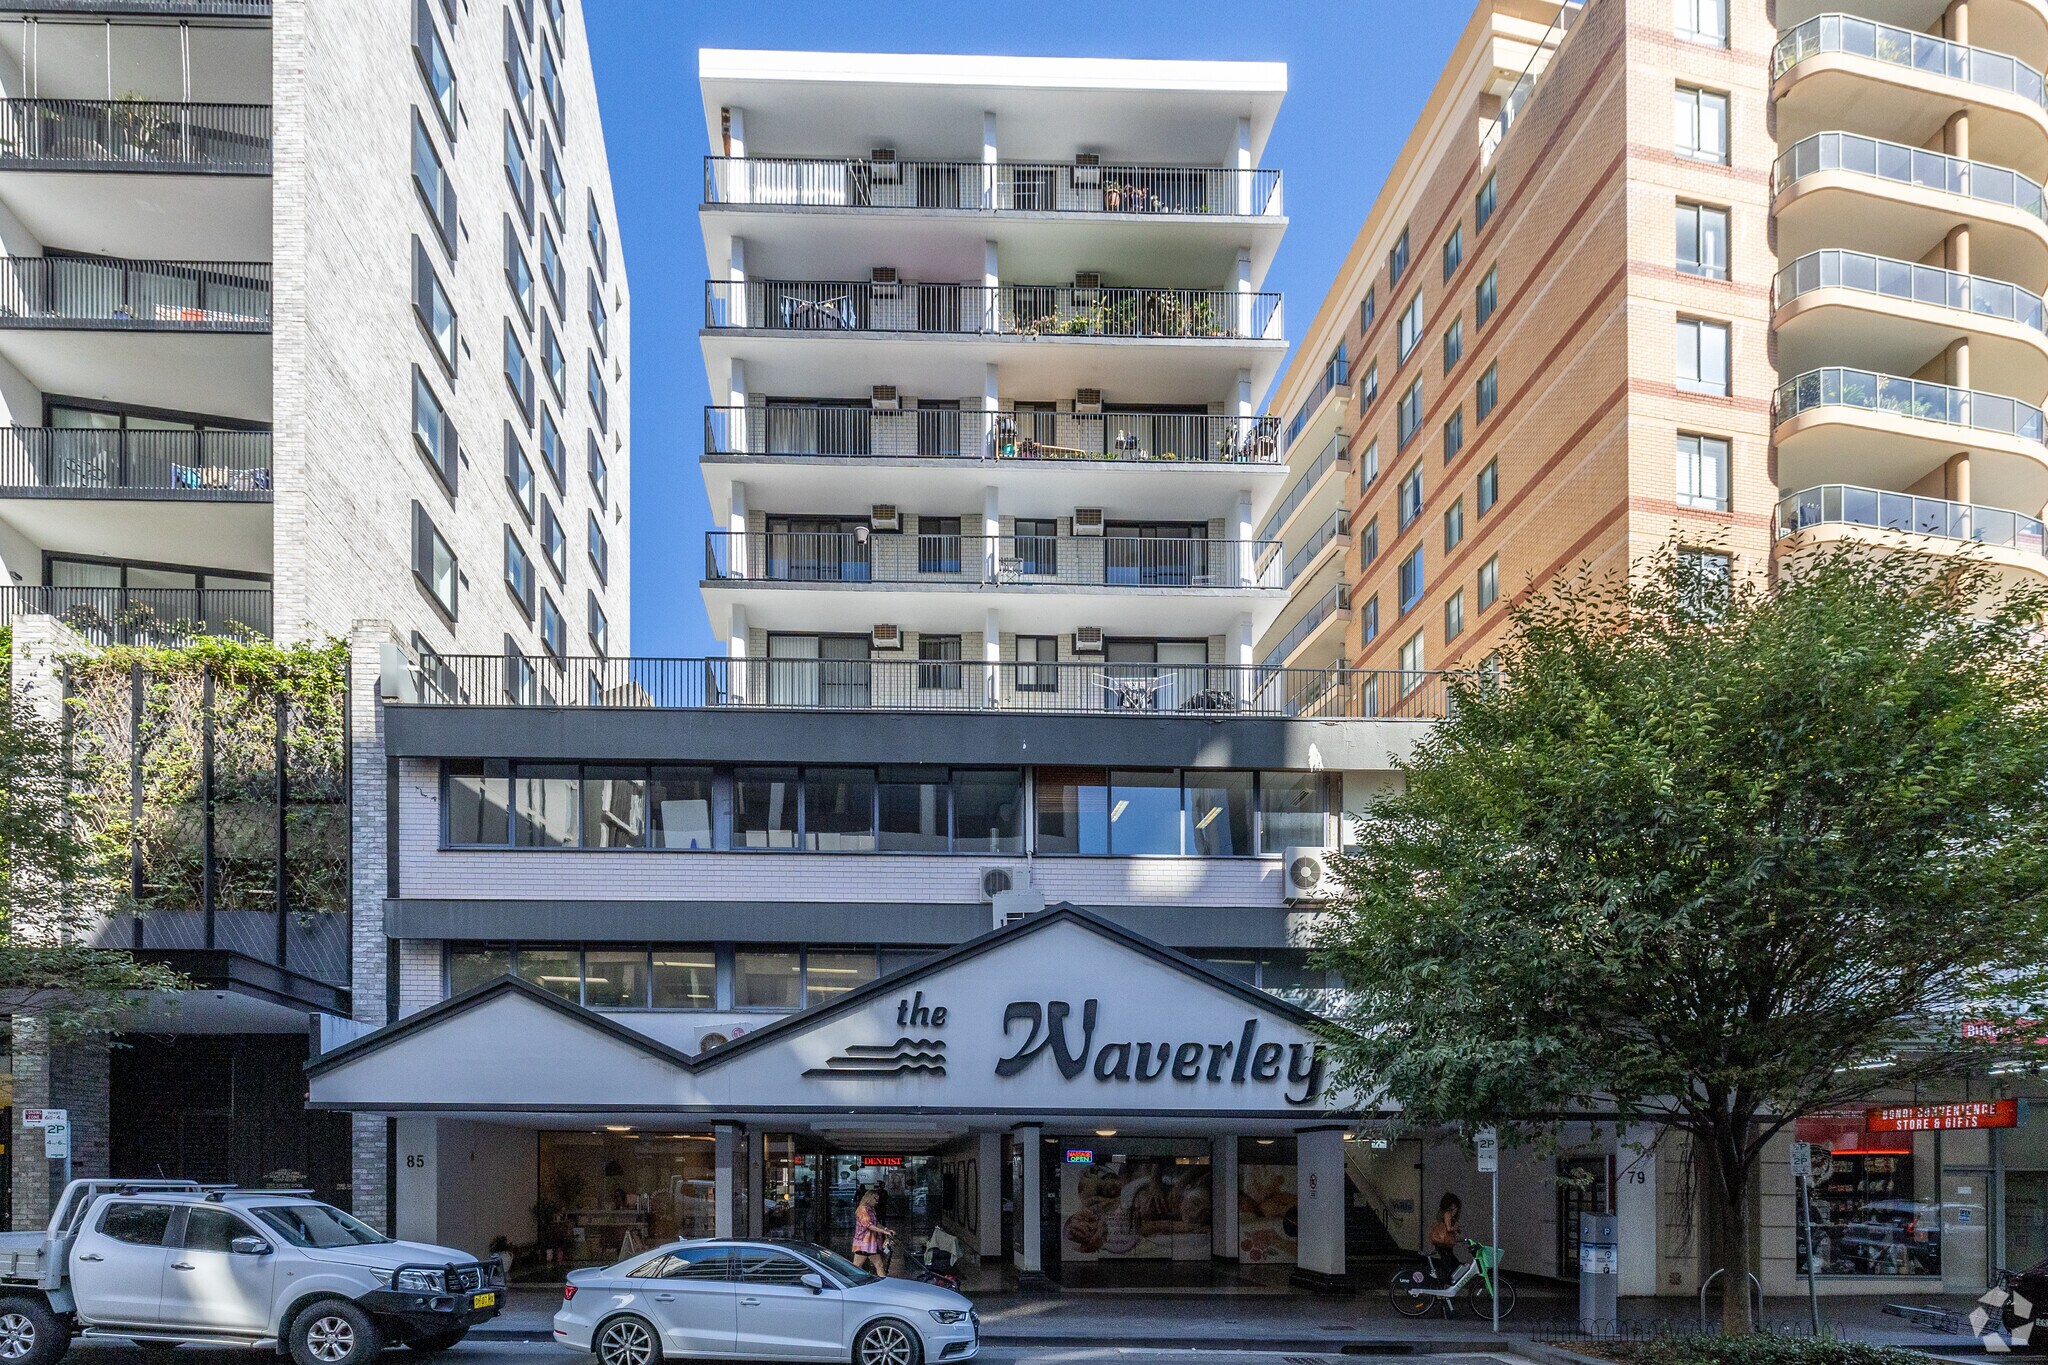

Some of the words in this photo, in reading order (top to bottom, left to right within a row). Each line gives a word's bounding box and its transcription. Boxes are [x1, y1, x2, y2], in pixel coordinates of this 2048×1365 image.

[897, 991, 947, 1026] the
[995, 999, 1326, 1105] Waverley
[47, 1124, 65, 1133] 2P
[1896, 1118, 1929, 1130] STORE
[1934, 1118, 1940, 1129] &
[1945, 1116, 1977, 1128] GIFTS
[1480, 1139, 1495, 1148] 2P
[407, 1155, 424, 1168] 85
[863, 1157, 902, 1165] DENTIST
[1628, 1171, 1645, 1184] 79
